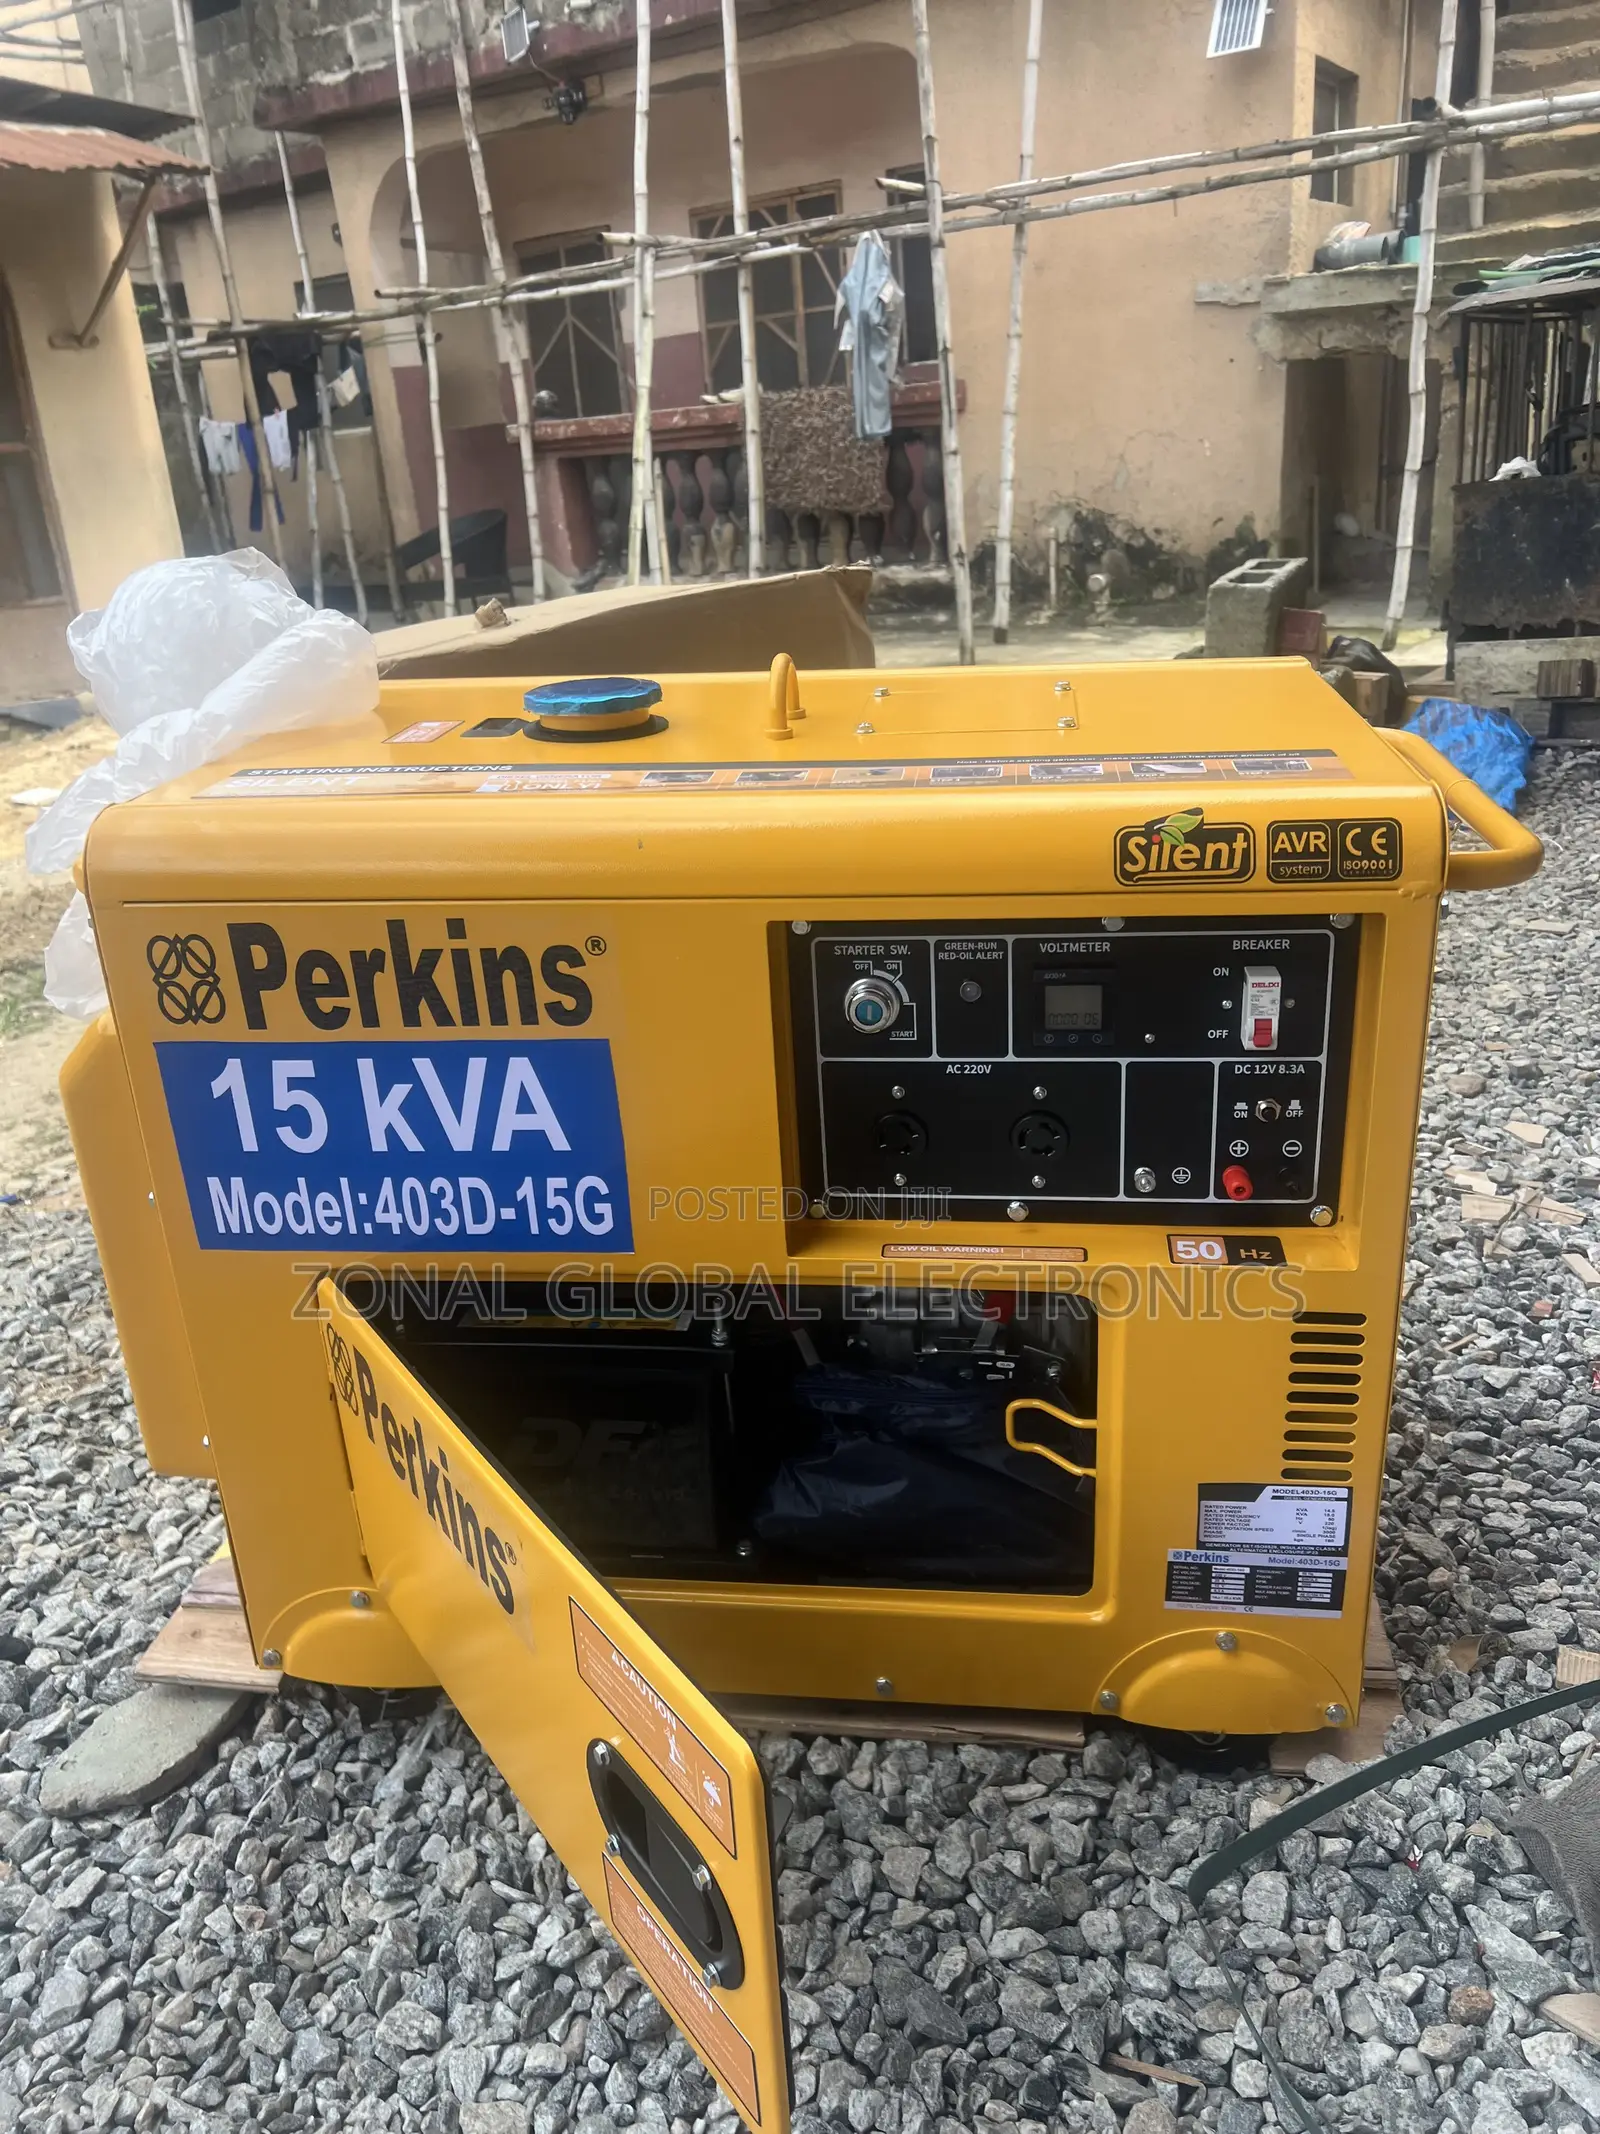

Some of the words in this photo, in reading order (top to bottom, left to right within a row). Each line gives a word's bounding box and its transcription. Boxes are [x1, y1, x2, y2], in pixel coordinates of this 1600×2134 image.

[247, 767, 355, 776] STARTING
[356, 764, 513, 774] INSTRUCTIONS
[223, 776, 370, 788] SILENT
[1273, 830, 1329, 853] AVR
[1123, 831, 1248, 873] Silent
[1279, 864, 1323, 877] system
[1343, 859, 1393, 871] ISO9001
[834, 945, 885, 956] STARTER
[889, 944, 911, 956] SW.
[944, 941, 998, 951] GREEN-RUN
[1039, 941, 1111, 953] VOLTMETER
[1232, 938, 1290, 950] BREAKER
[938, 951, 974, 960] RED-OIL
[976, 951, 1004, 960] ALERT
[854, 963, 869, 971] OFF
[886, 963, 898, 971] ON
[1212, 967, 1230, 977] ON
[891, 1030, 914, 1038] START
[1207, 1029, 1229, 1039] OFF
[946, 1064, 962, 1074] AC
[963, 1064, 992, 1074] 220V
[1234, 1064, 1252, 1075] DC
[1254, 1064, 1277, 1075] 12V
[1278, 1064, 1305, 1075] 8.3A
[210, 1058, 328, 1154] 15
[356, 1056, 572, 1153] kVA
[1233, 1110, 1248, 1119] ON
[1285, 1109, 1304, 1118] OFF
[206, 1175, 615, 1237] Model:403D-15G
[941, 1246, 1004, 1254] WARNING!
[1175, 1240, 1223, 1261] 50
[1239, 1247, 1272, 1261] Hz
[1183, 1551, 1230, 1564] Perkins
[1268, 1556, 1341, 1567] Model:403D-15G
[619, 1659, 677, 1732] CAUTION
[635, 1904, 715, 2015] OPERATION
